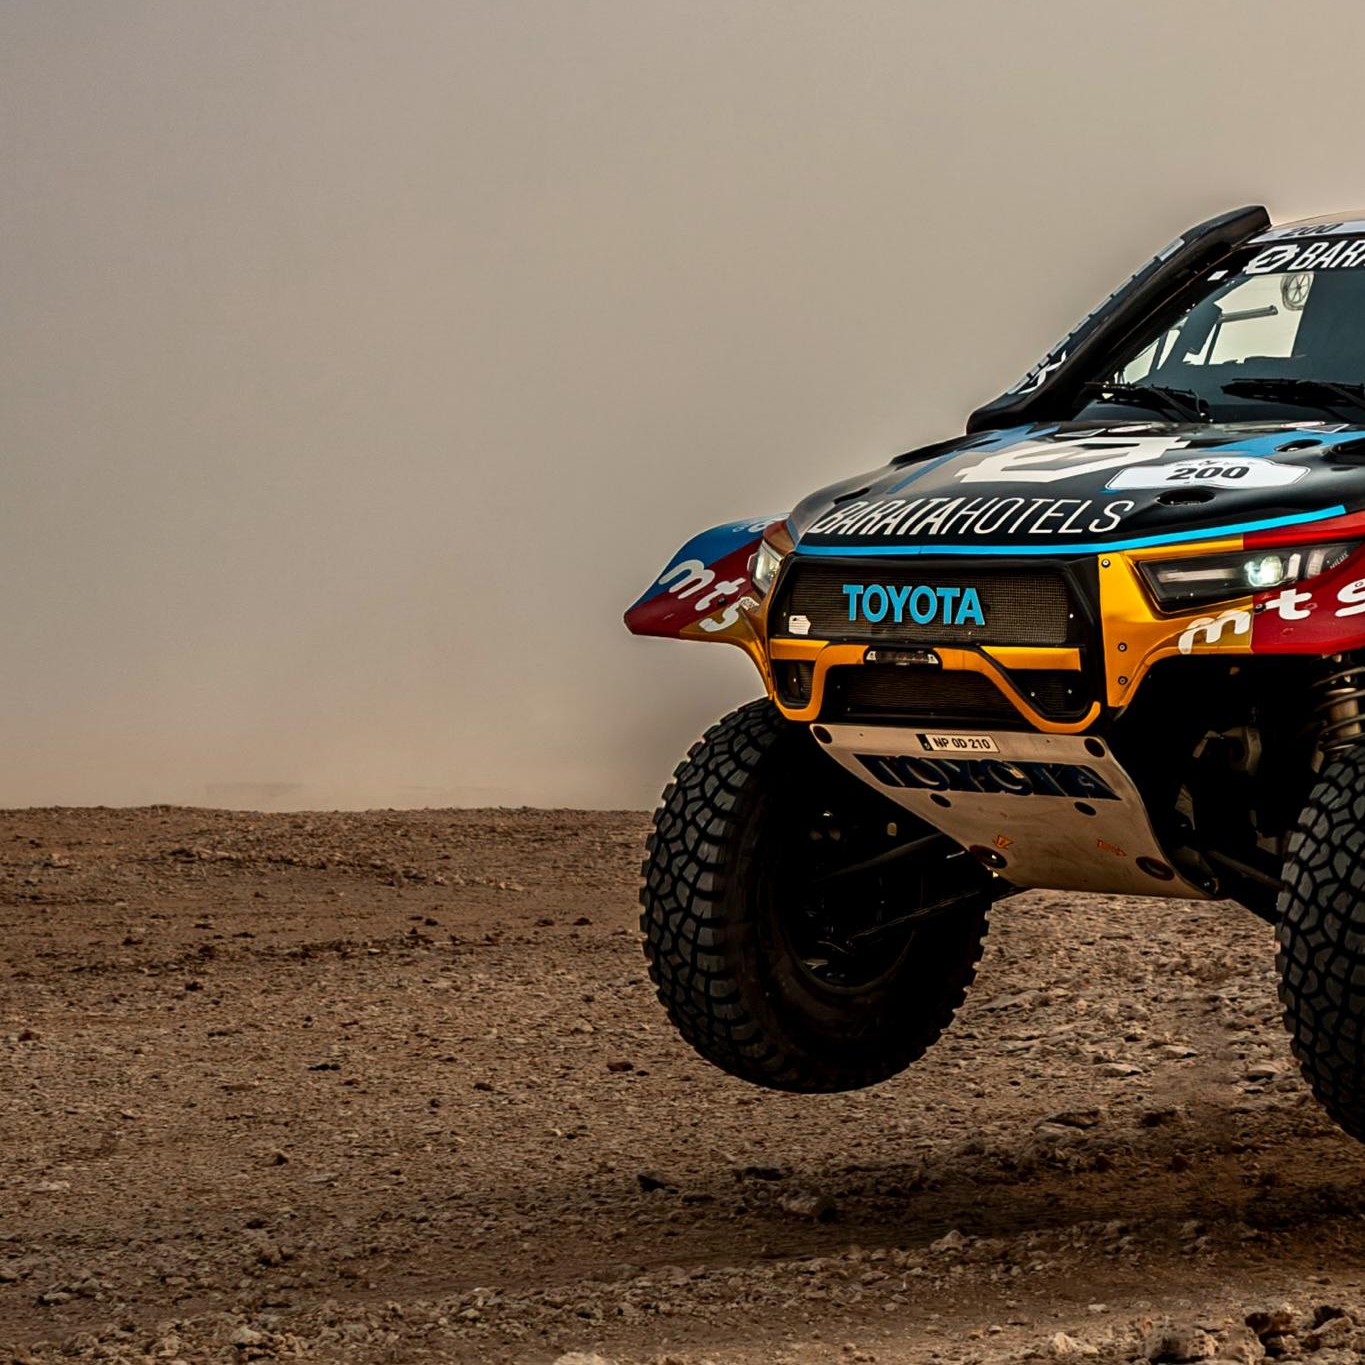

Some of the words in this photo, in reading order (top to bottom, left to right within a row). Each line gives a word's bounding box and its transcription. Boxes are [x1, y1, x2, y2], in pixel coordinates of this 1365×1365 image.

[1165, 466, 1251, 481] 200
[842, 583, 986, 627] TOYOTA
[932, 737, 950, 748] NP
[968, 738, 991, 749] 210
